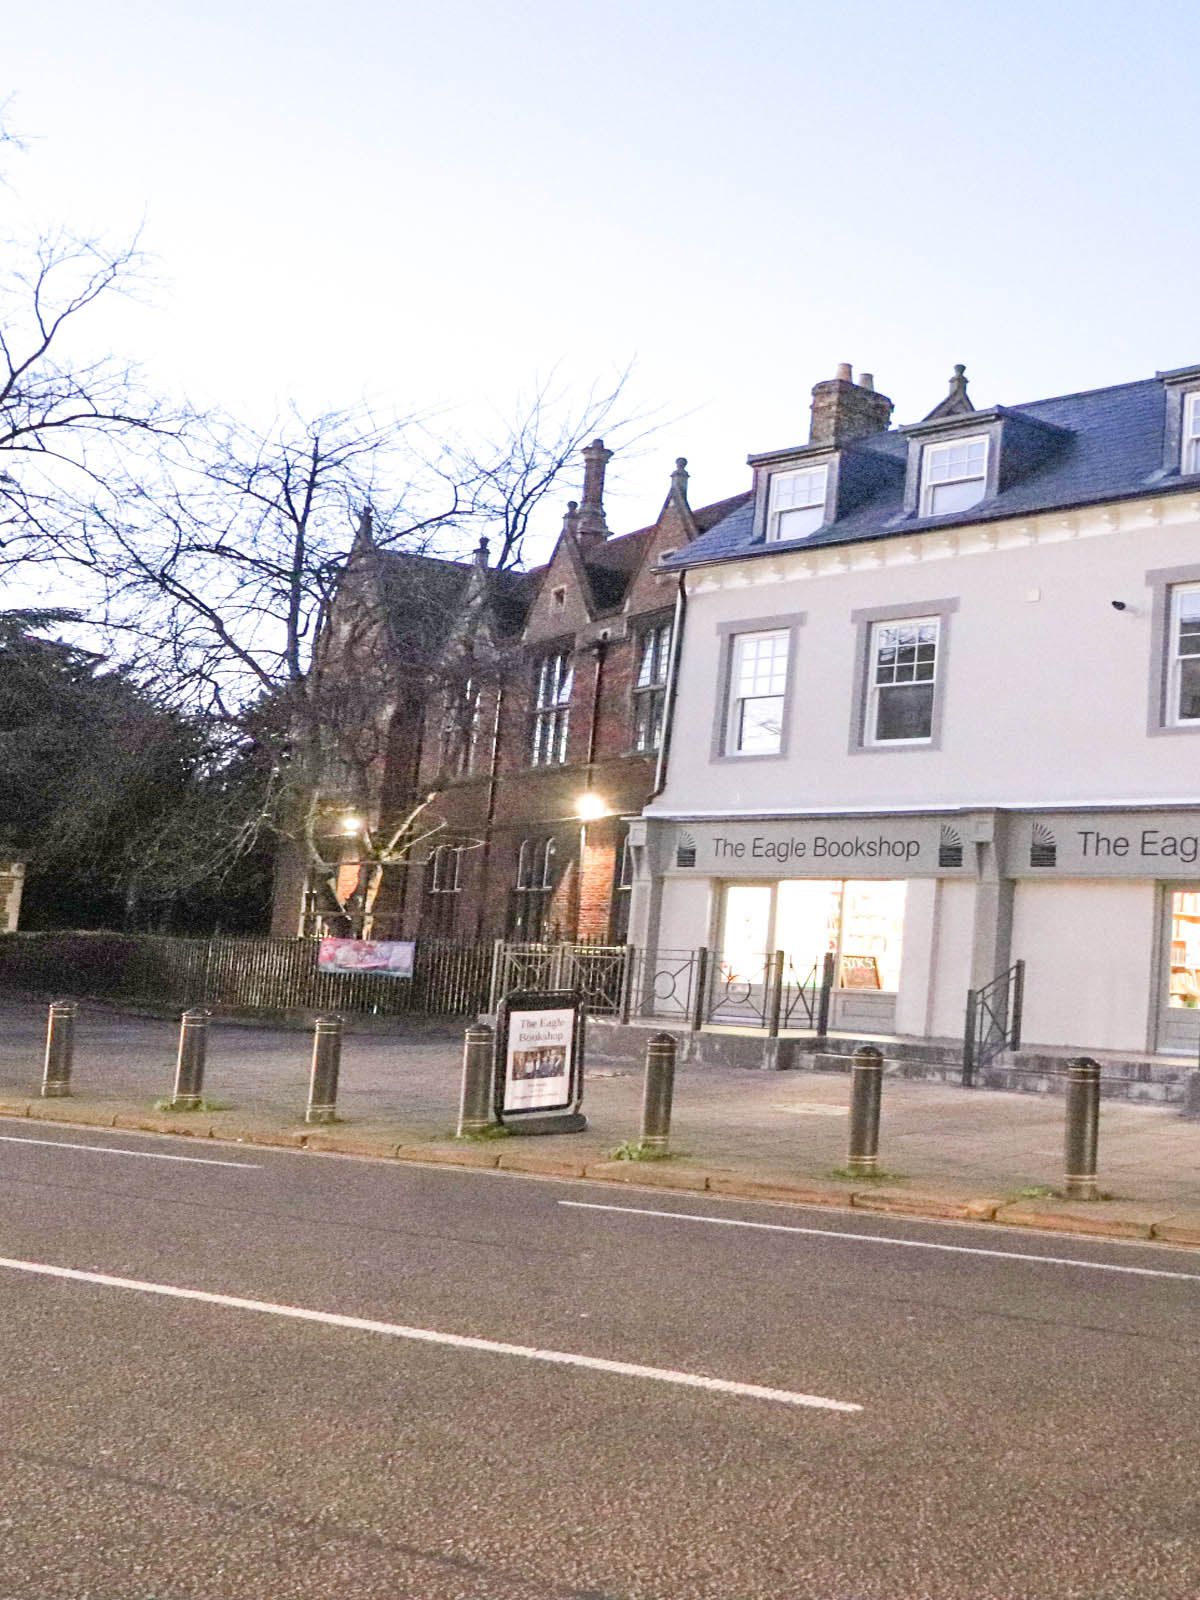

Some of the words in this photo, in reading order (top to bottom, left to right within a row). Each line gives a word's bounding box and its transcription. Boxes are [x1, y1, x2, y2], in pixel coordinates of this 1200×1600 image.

[711, 837, 746, 858] The
[751, 837, 807, 863] Eagle
[813, 835, 921, 863] Bookshop
[1076, 831, 1130, 857] The
[521, 1020, 537, 1029] The
[540, 1018, 565, 1029] Eagle
[519, 1031, 564, 1042] Bookshop
